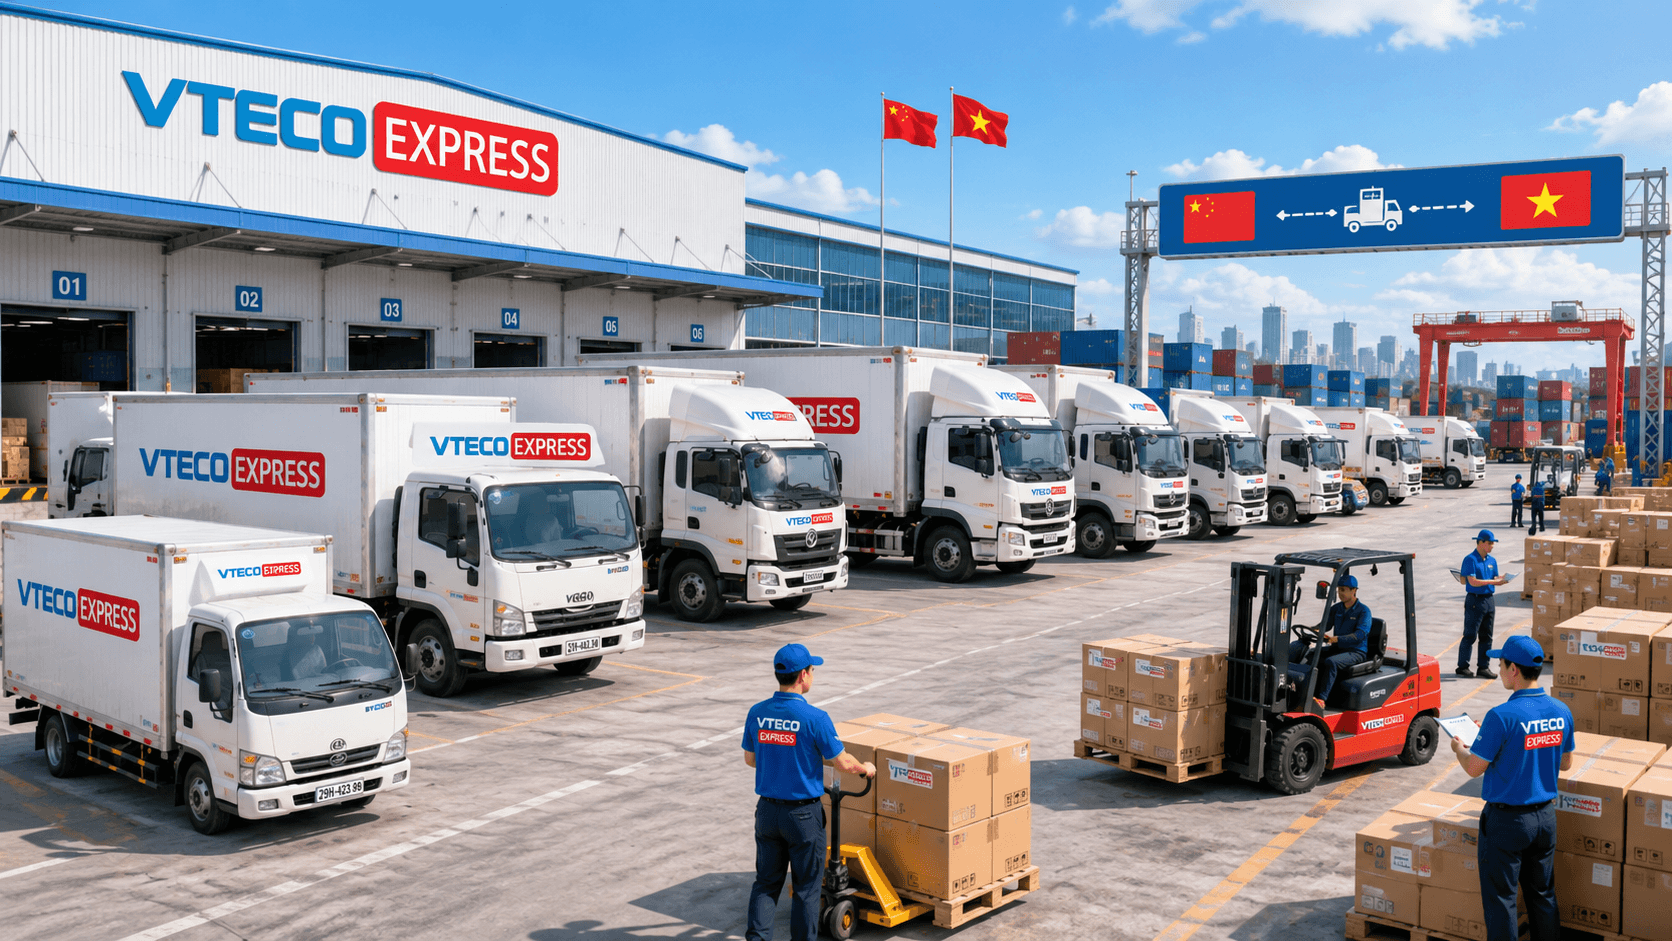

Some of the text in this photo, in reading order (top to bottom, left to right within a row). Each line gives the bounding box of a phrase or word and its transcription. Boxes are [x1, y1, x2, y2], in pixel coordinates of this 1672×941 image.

[121, 70, 551, 183] VTECO EXPRESS
[58, 276, 80, 296] 01
[240, 291, 259, 308] 02
[384, 302, 400, 317] 03
[504, 311, 518, 326] 04
[692, 327, 703, 340] 06
[795, 404, 855, 428] RESS
[429, 436, 587, 456] VTECO EXPRESS
[138, 447, 321, 489] VTECO EXPRESS
[217, 566, 261, 579] VTECO
[17, 578, 137, 633] VTECO EXPRESS
[757, 716, 801, 732] VTECO
[1520, 717, 1565, 734] VTECO
